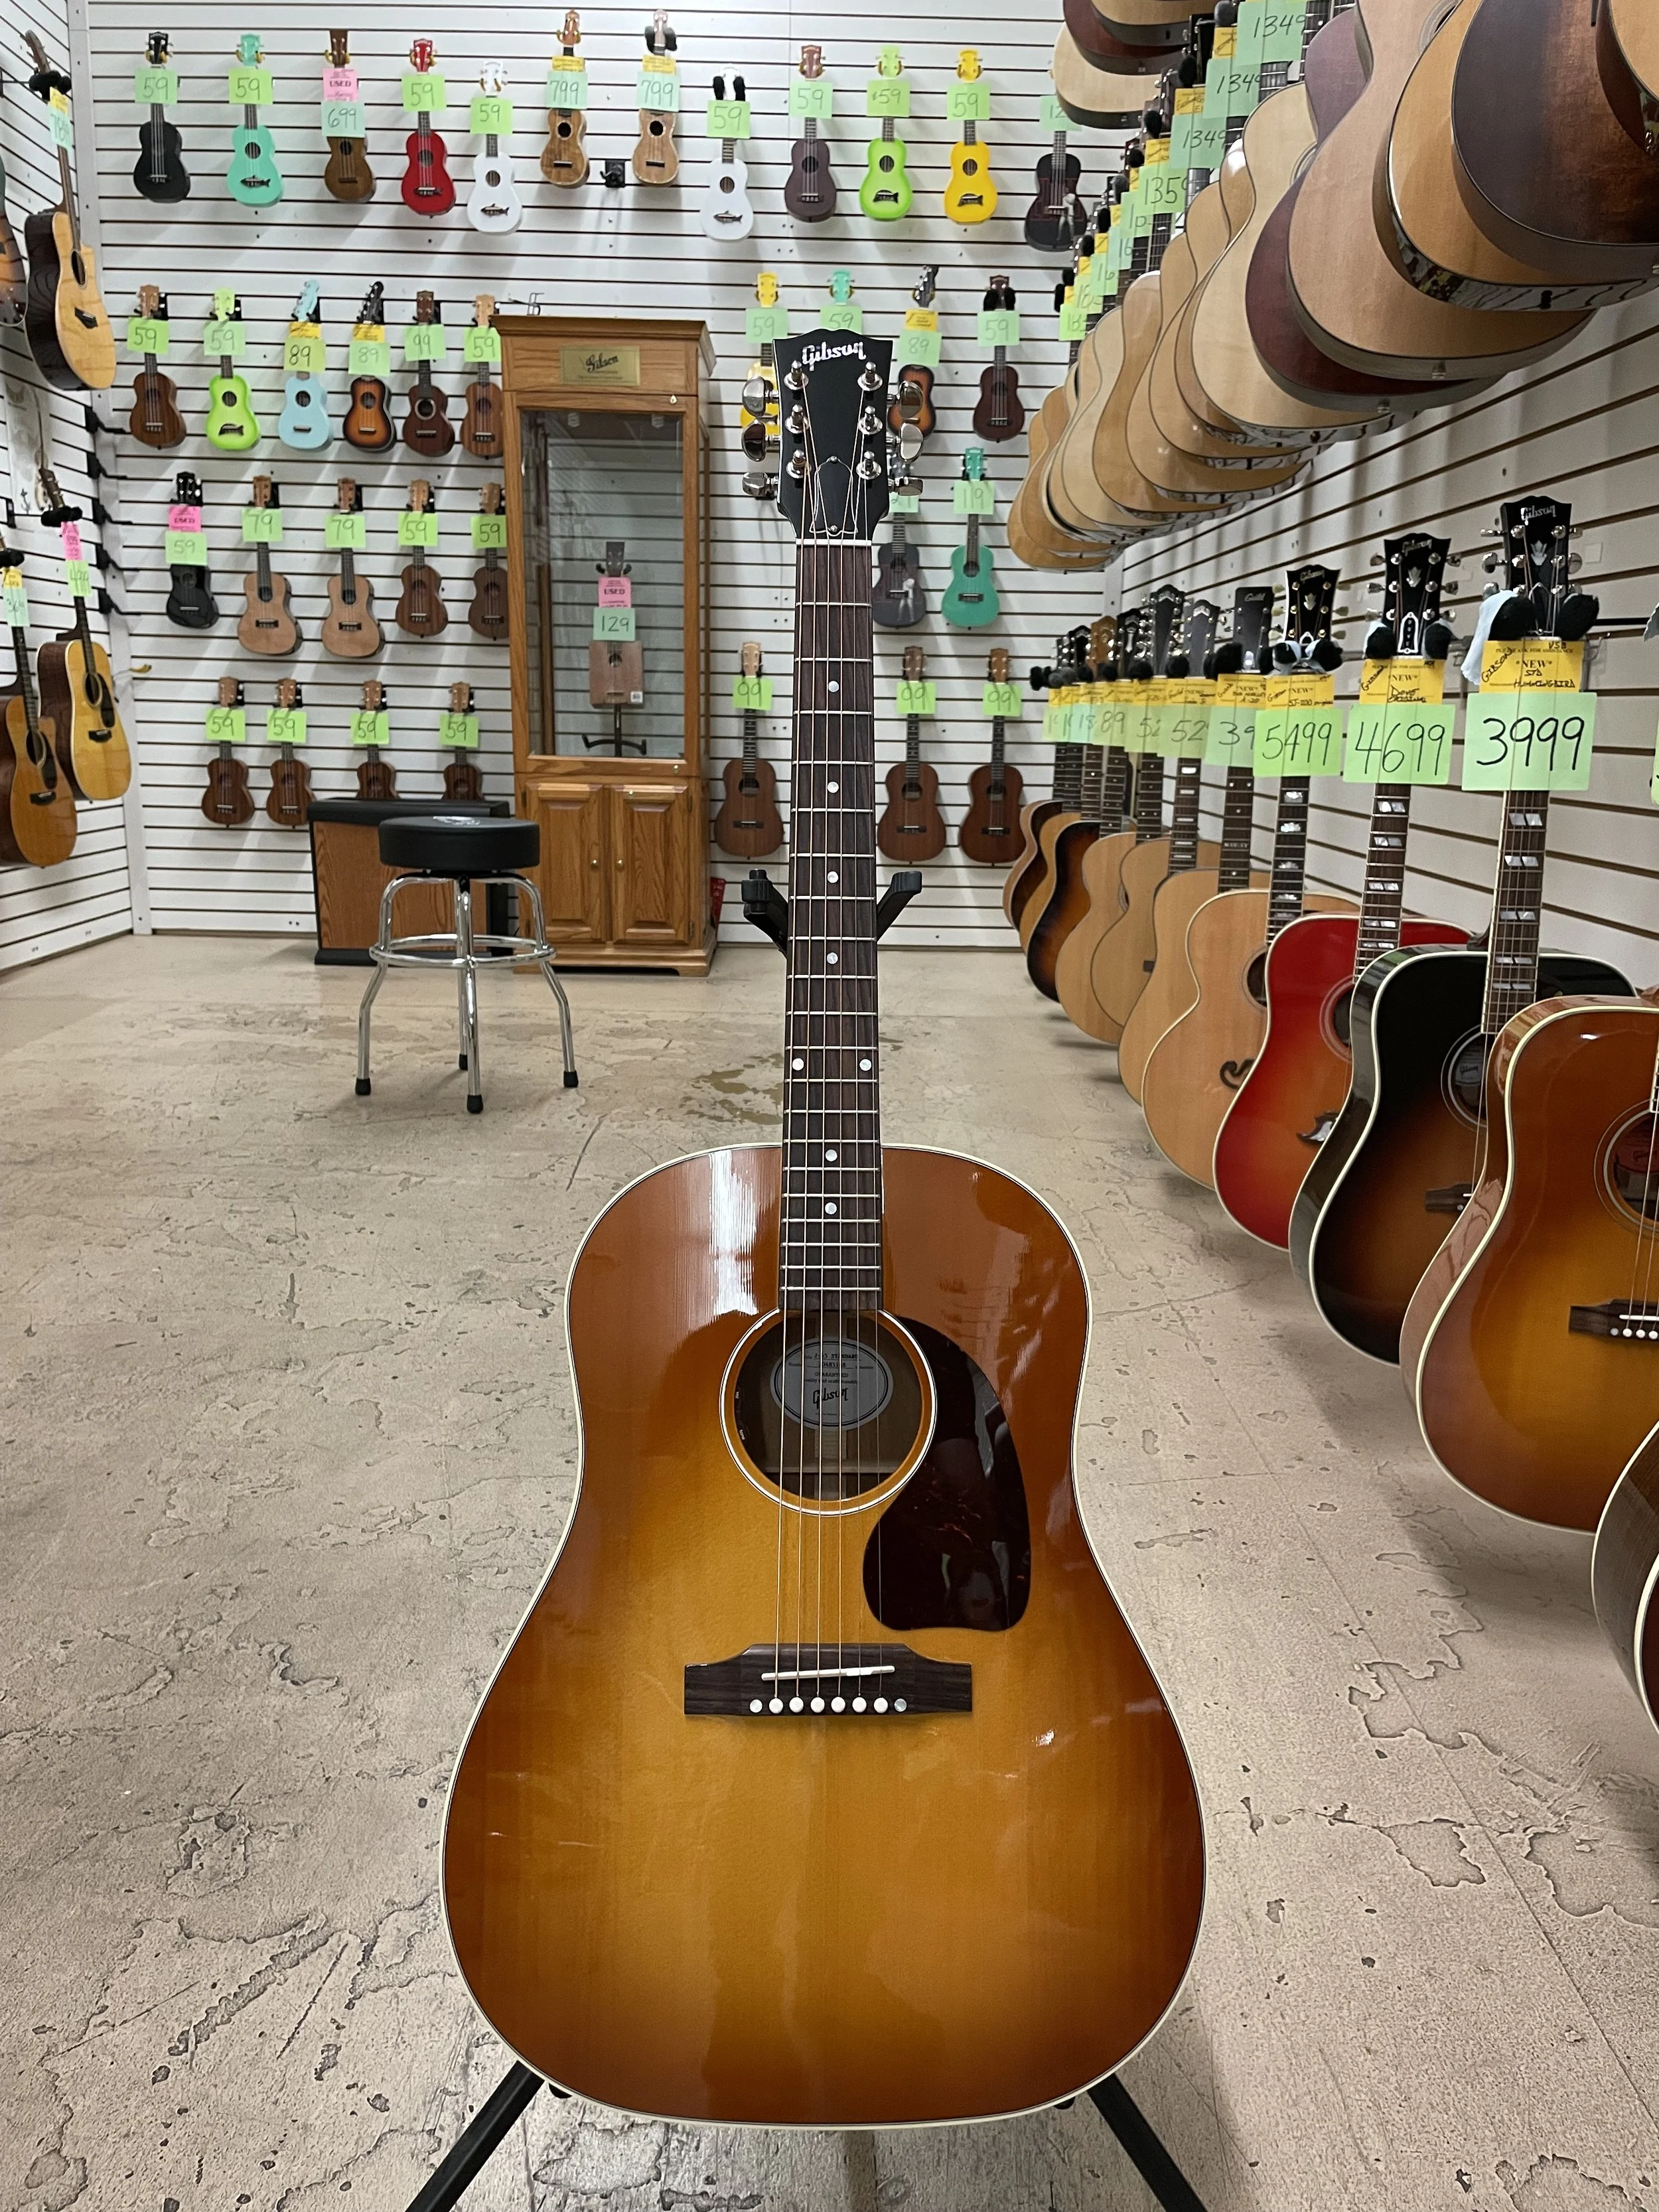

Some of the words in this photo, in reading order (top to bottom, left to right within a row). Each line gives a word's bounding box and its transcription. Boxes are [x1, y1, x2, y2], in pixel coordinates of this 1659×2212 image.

[143, 77, 169, 100] 59
[236, 77, 260, 100] 59
[410, 82, 435, 106] 59
[550, 80, 579, 105] 799
[641, 80, 674, 106] 799
[797, 88, 823, 111] 59
[479, 104, 501, 122] 59
[952, 92, 979, 117] 59
[328, 108, 357, 130] 699
[713, 106, 743, 131] 59
[753, 315, 775, 336] 59
[985, 319, 1010, 342] 59
[134, 327, 157, 350] 59
[211, 329, 235, 350] 59
[413, 334, 431, 356] 99
[472, 335, 496, 358] 59
[908, 337, 929, 355] 89
[289, 344, 311, 367] 89
[358, 346, 379, 364] 89
[585, 352, 619, 373] Gibson
[802, 341, 867, 371] Gibson
[247, 512, 273, 536] 79
[1520, 504, 1557, 526] Gibson
[331, 518, 354, 542] 79
[405, 520, 427, 542] 59
[479, 523, 501, 544] 59
[174, 539, 196, 554] 59
[602, 615, 629, 632] 129
[737, 681, 762, 706] 99
[901, 686, 926, 710] 99
[987, 690, 1011, 711] 99
[211, 716, 234, 737] 59
[273, 717, 295, 738] 59
[357, 720, 376, 739] 59
[445, 721, 467, 741] 59
[1262, 721, 1332, 766] 5499
[1354, 721, 1445, 776] 4699
[1476, 716, 1585, 771] 3999
[813, 1387, 848, 1410] Gbson
